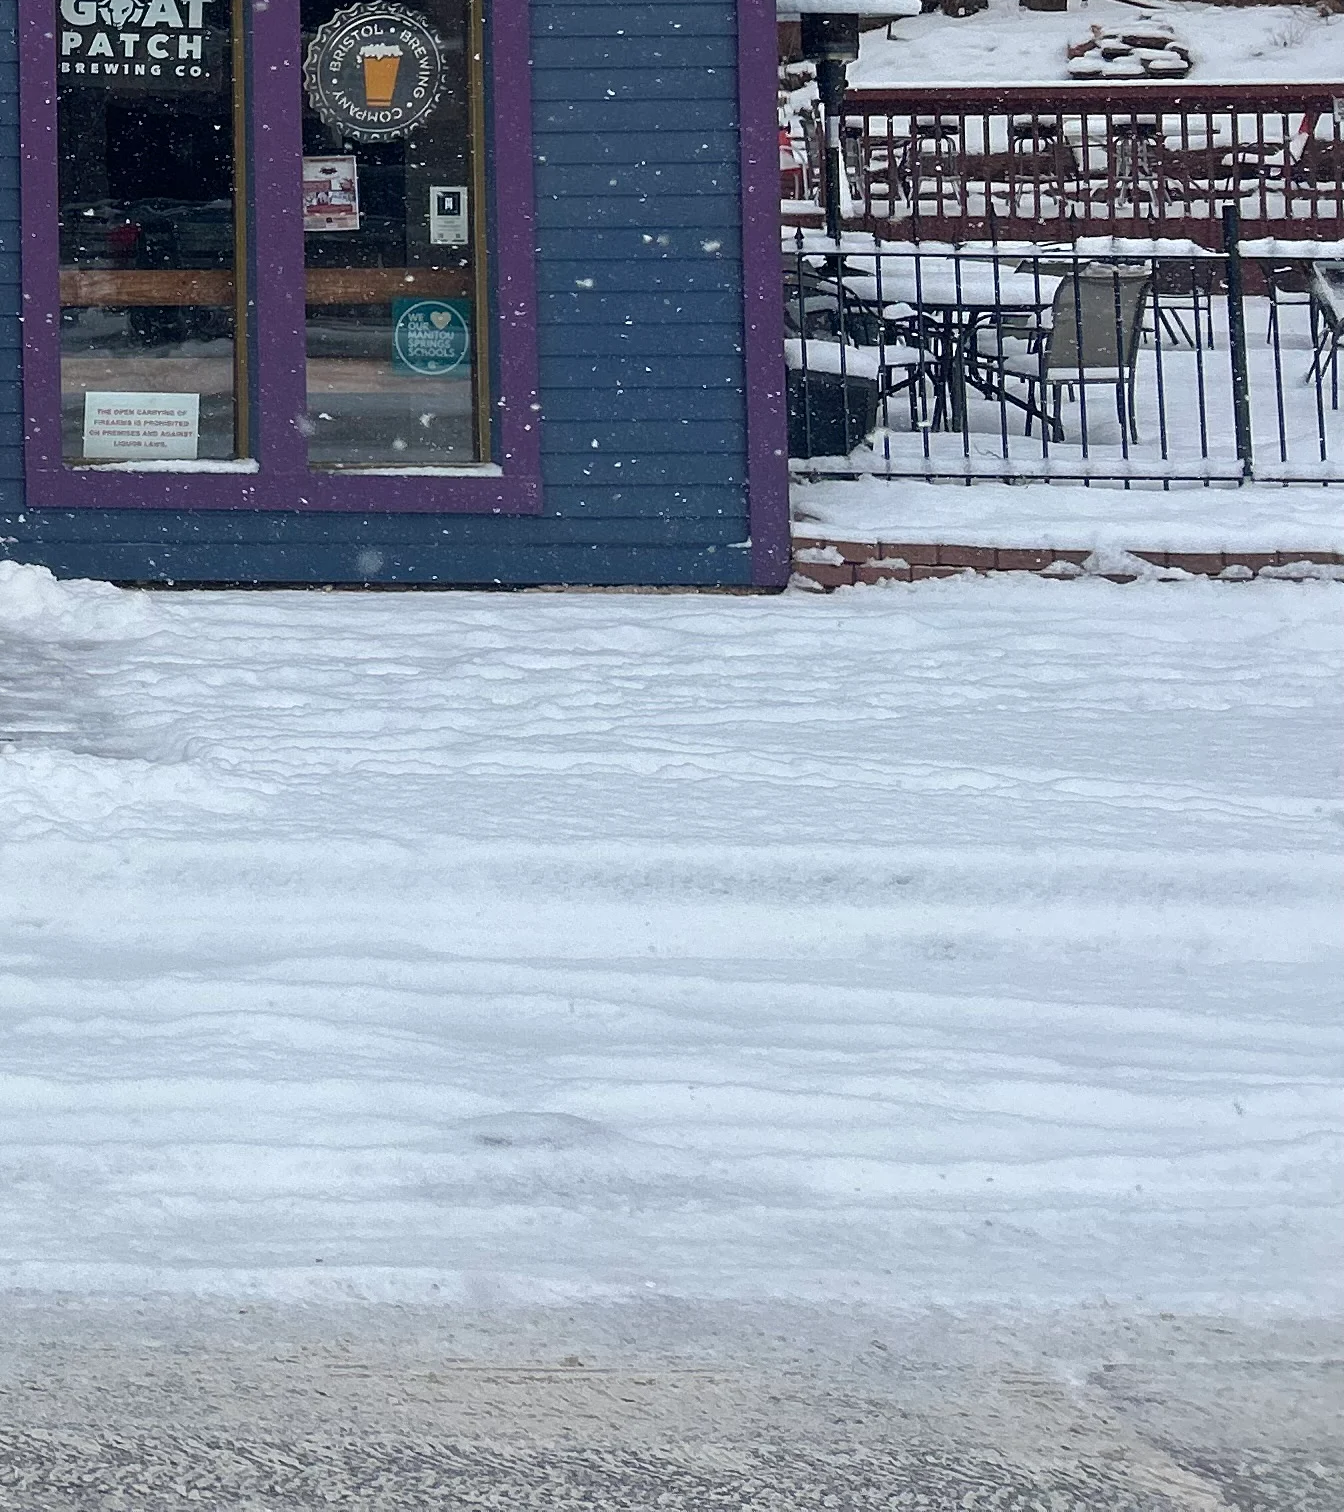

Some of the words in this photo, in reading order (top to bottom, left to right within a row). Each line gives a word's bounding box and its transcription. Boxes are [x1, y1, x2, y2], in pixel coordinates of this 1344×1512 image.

[62, 31, 202, 59] PATCH
[329, 24, 384, 72] BRISTOL
[61, 62, 161, 76] BREWING
[175, 65, 210, 78] CO.
[400, 29, 432, 99] BREWING
[332, 90, 403, 123] COMPANY
[407, 313, 424, 321] WE
[407, 322, 430, 330] OUR
[407, 331, 455, 340] MANITOU
[407, 339, 451, 348] SPRINGS
[408, 348, 455, 357] SCHOOLS
